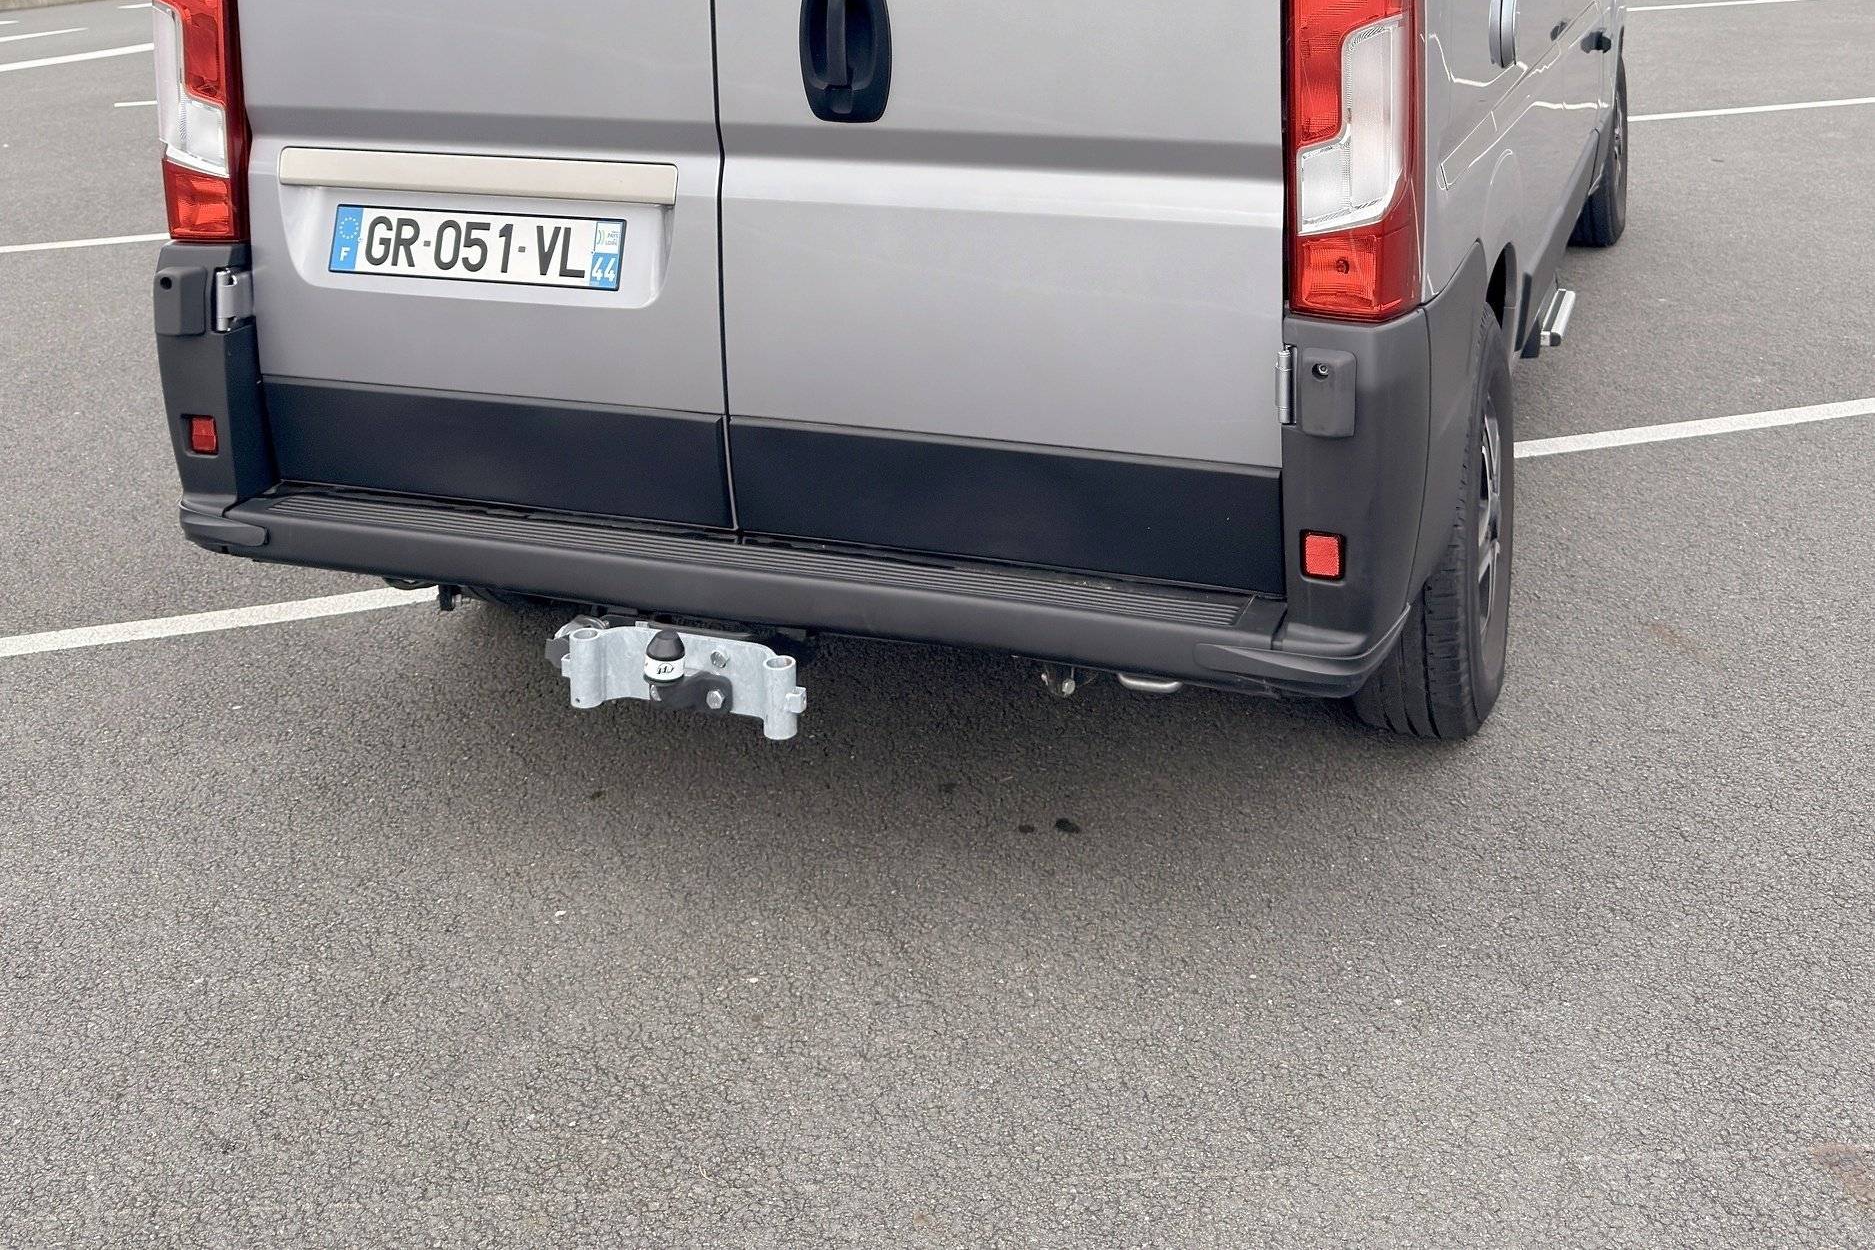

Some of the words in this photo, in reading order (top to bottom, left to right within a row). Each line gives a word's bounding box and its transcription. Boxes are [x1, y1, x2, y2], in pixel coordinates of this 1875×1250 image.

[339, 246, 351, 261] F
[364, 215, 586, 279] GR-051-VL
[591, 256, 617, 282] 44
